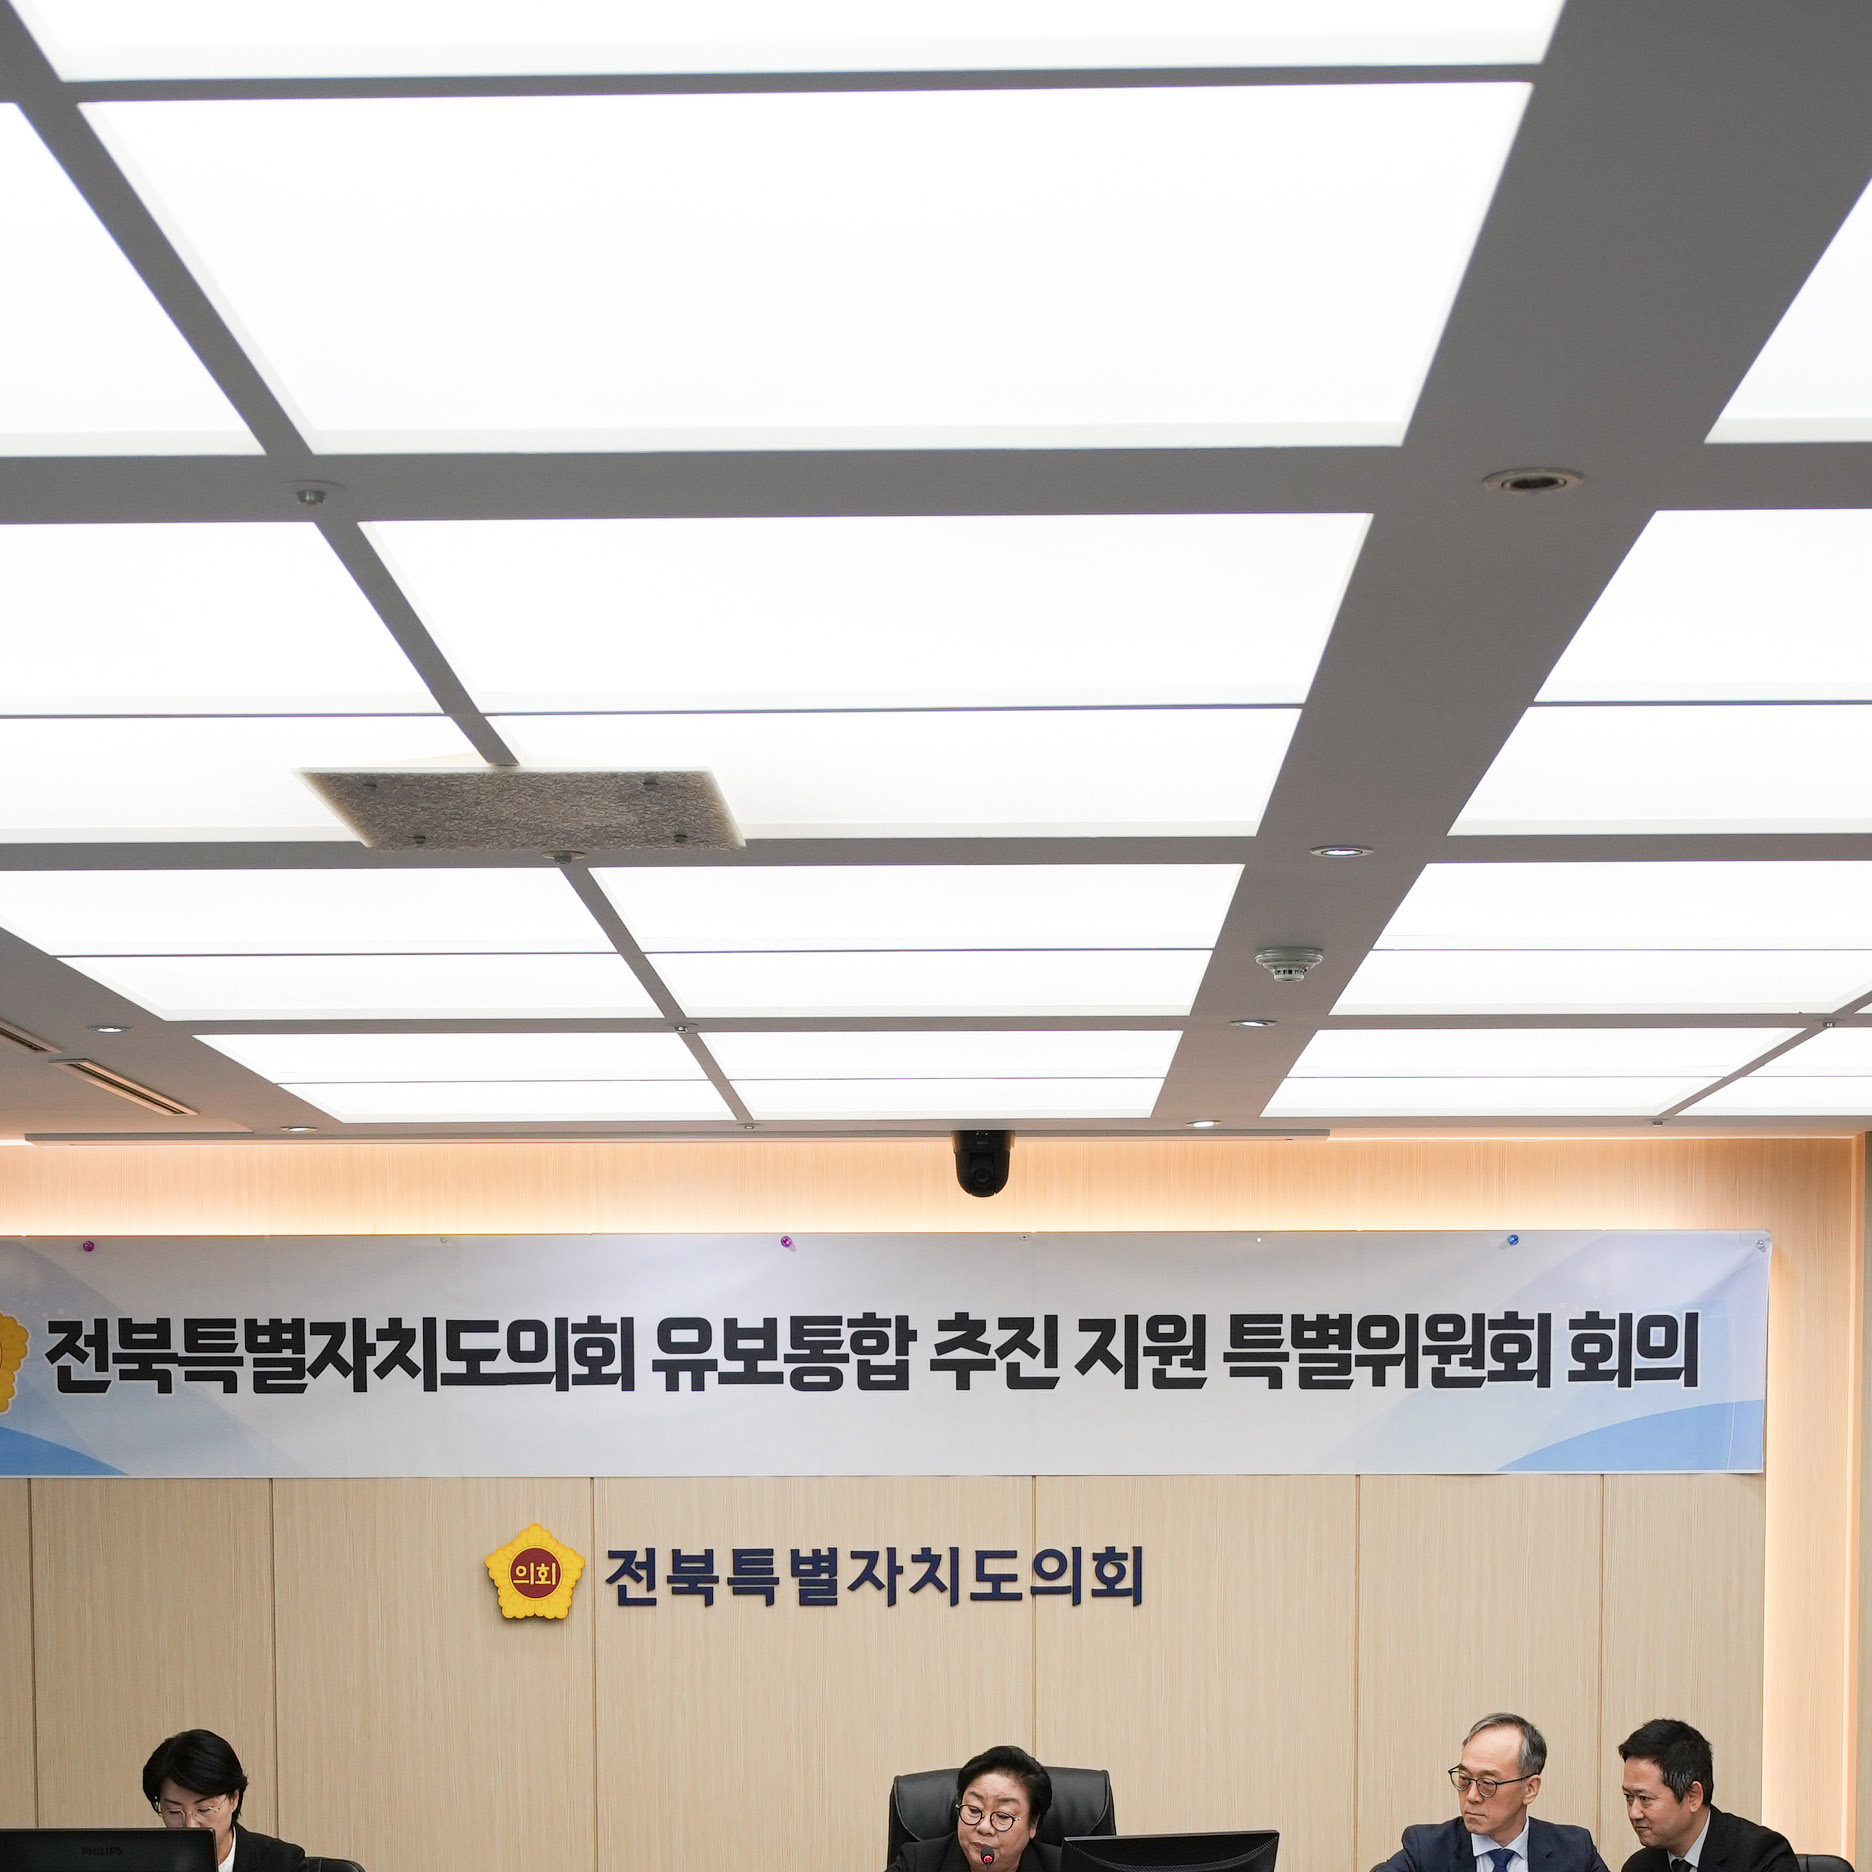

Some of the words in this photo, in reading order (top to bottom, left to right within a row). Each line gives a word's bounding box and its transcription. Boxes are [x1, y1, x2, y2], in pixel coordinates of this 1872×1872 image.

[44, 1314, 635, 1395] 전북특별자치도의회
[653, 1312, 917, 1393] 유보통합
[931, 1311, 1061, 1391] 추진
[1074, 1313, 1207, 1391] 지원
[1221, 1310, 1551, 1390] 특별위원회
[1566, 1309, 1701, 1388] 회의
[511, 1562, 558, 1588] 의회
[605, 1546, 1146, 1609] 전북특별자치도의회
